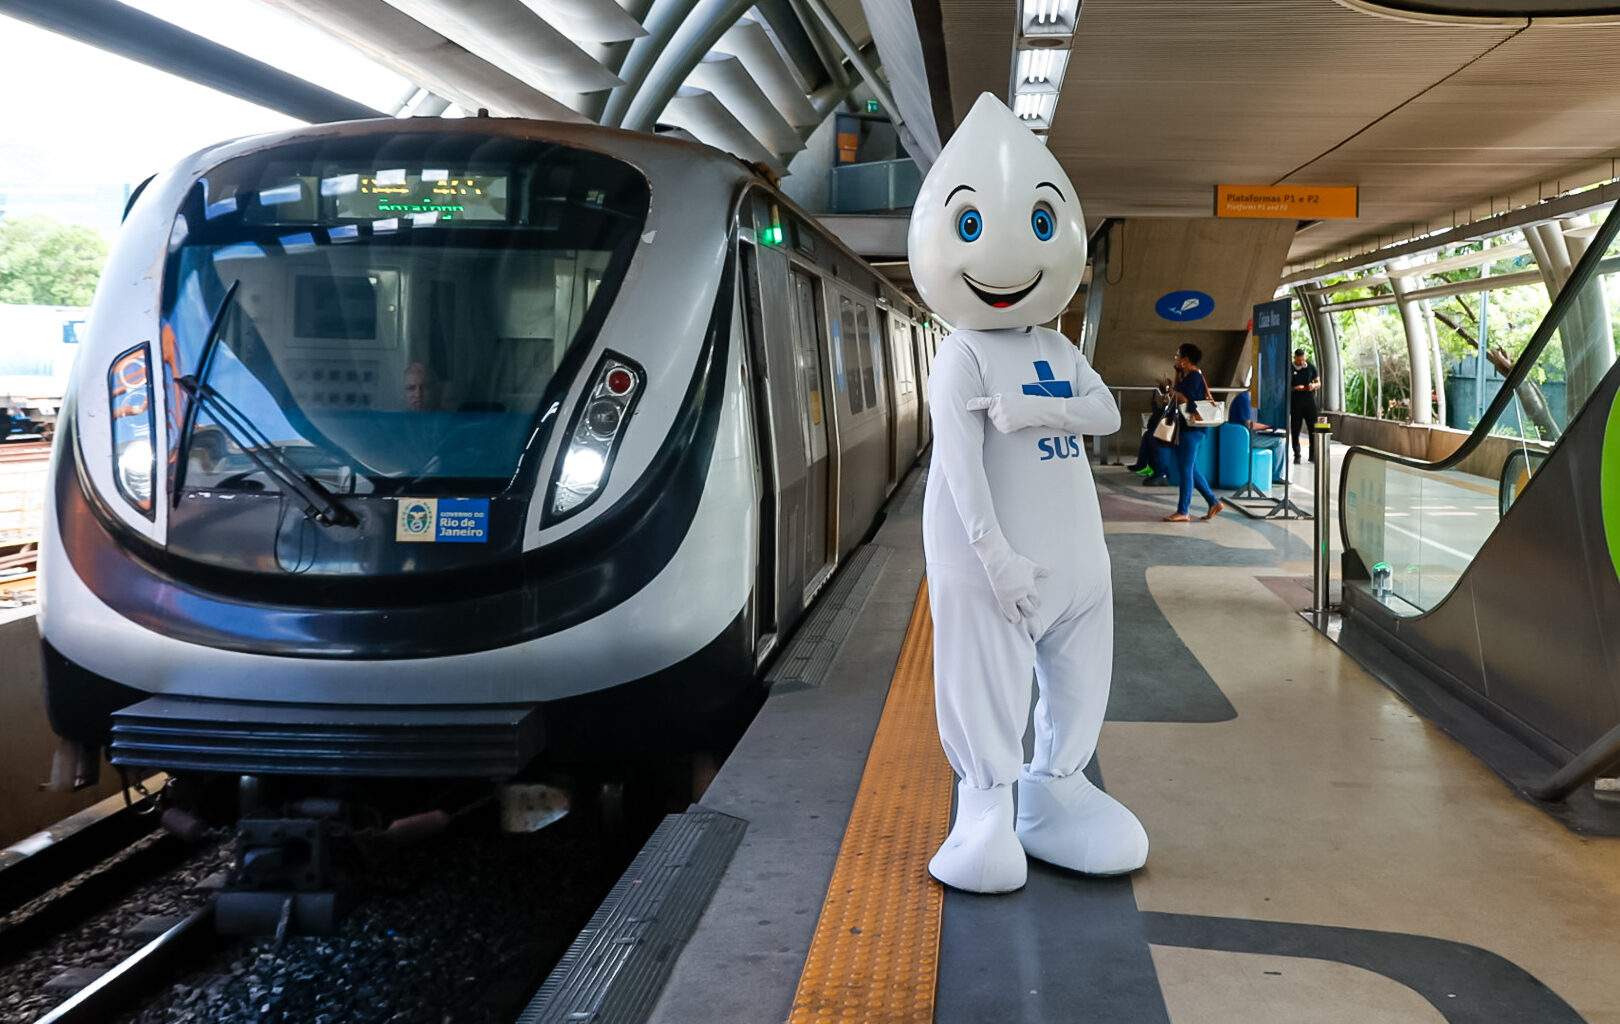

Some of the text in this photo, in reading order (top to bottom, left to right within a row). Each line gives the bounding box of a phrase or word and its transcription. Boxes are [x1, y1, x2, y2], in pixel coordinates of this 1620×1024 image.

[1227, 194, 1280, 202] Plataformas
[1284, 194, 1295, 203] P1
[1307, 195, 1319, 203] P2
[1038, 434, 1080, 461] SUS
[440, 518, 476, 527] Rio de
[440, 527, 484, 537] Janeiro
